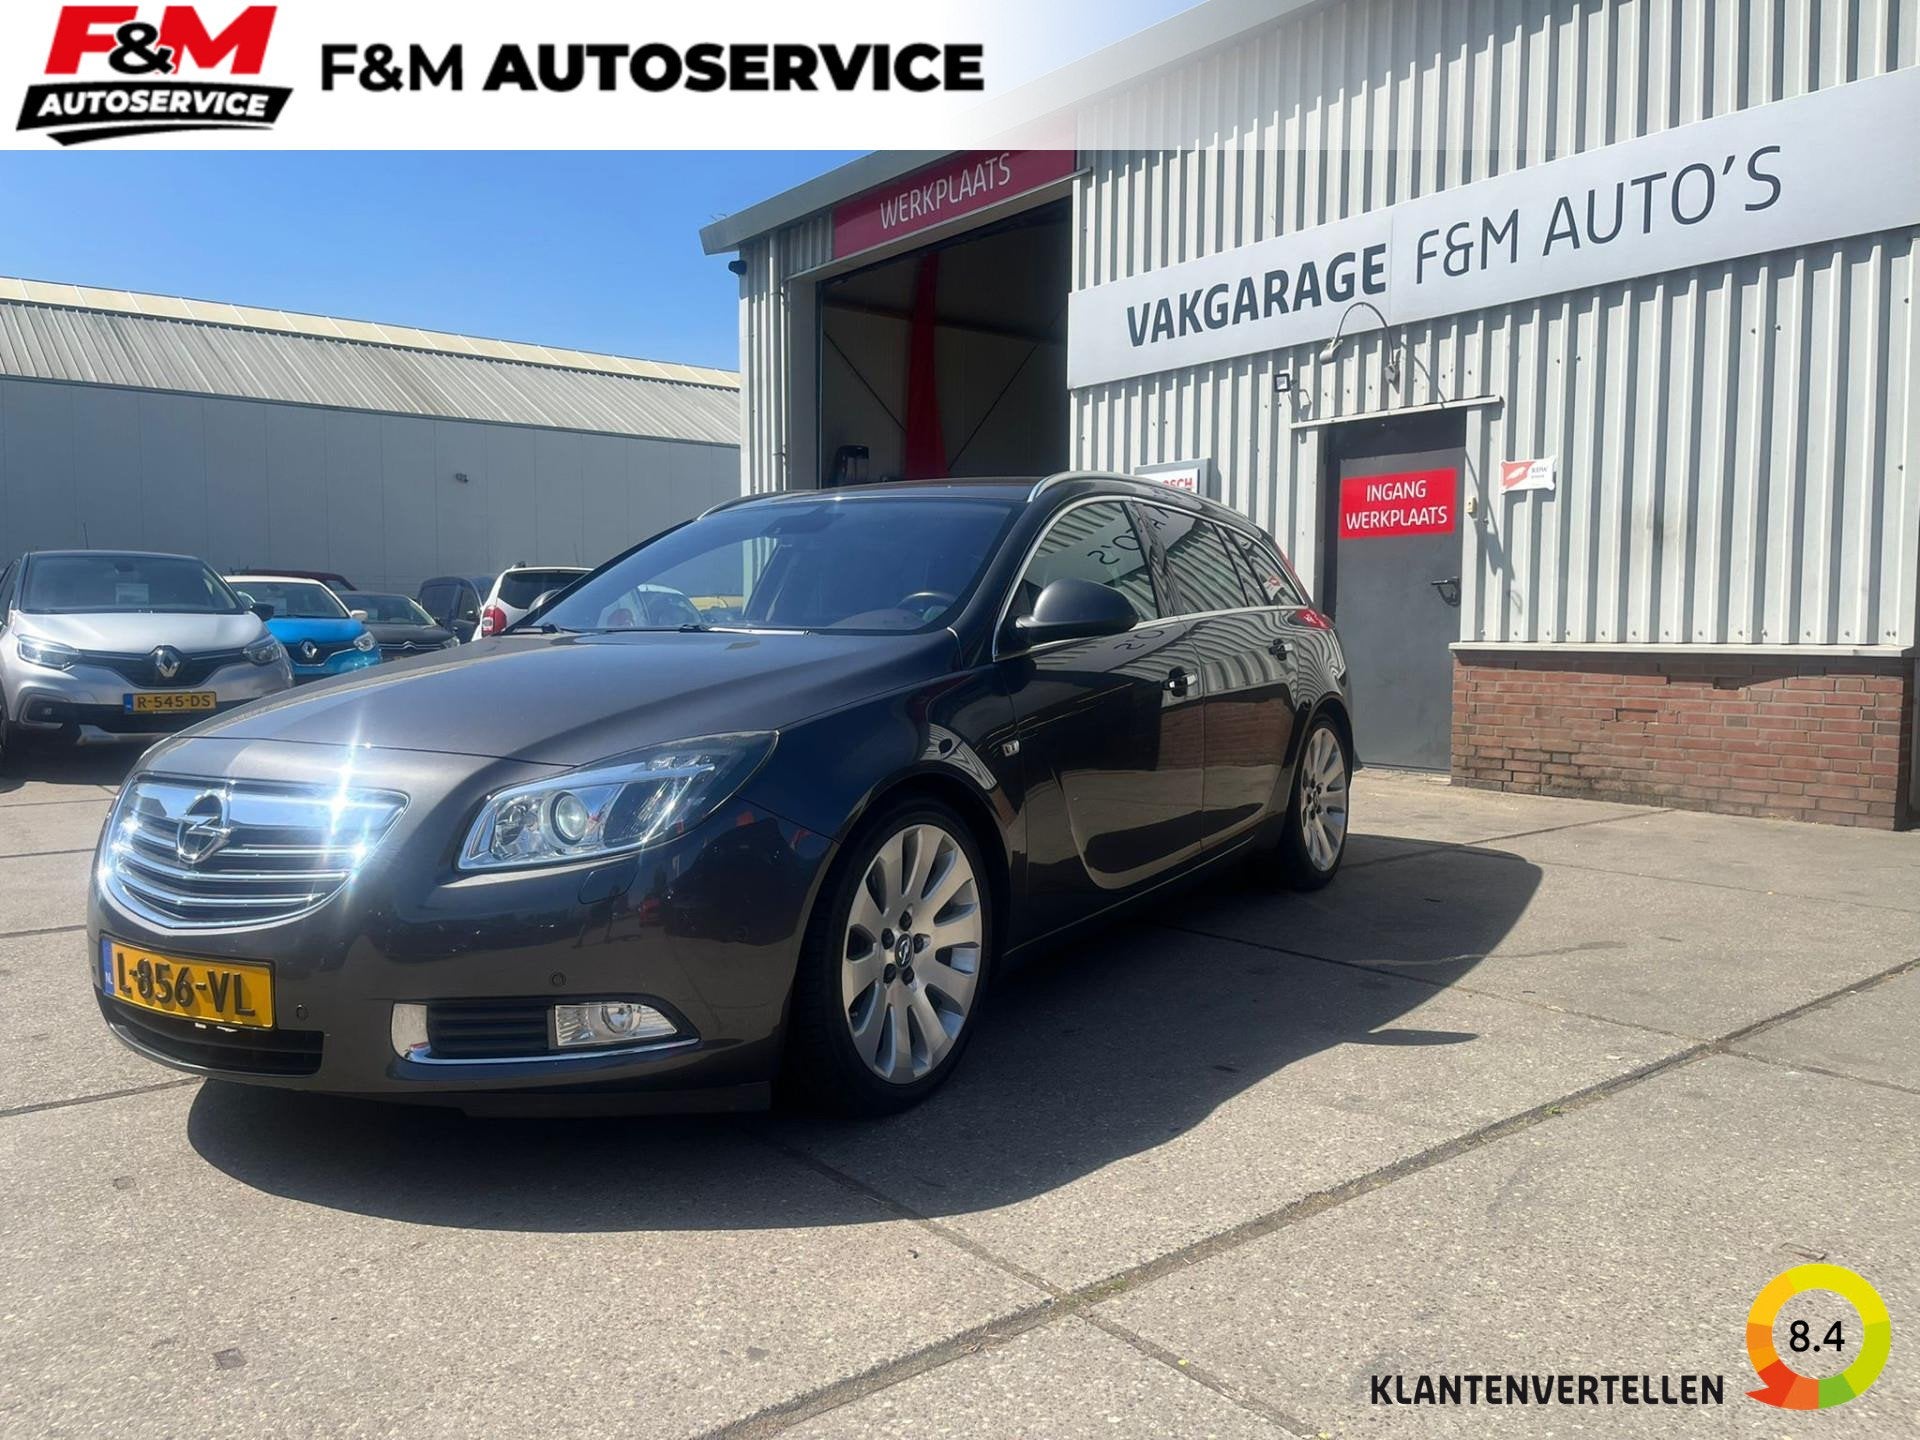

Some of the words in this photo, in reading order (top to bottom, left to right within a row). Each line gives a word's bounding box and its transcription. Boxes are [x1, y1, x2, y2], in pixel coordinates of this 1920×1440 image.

[880, 152, 1011, 230] WERKPLAATS
[1126, 242, 1387, 348] VAKGARAGE
[1416, 208, 1519, 285] F&M
[1542, 145, 1782, 257] AUTO'S
[1366, 480, 1427, 502] INGANG
[1346, 506, 1448, 530] WERKPLAATS
[136, 695, 212, 709] R-545-DS
[117, 953, 257, 1017] L-856-VL
